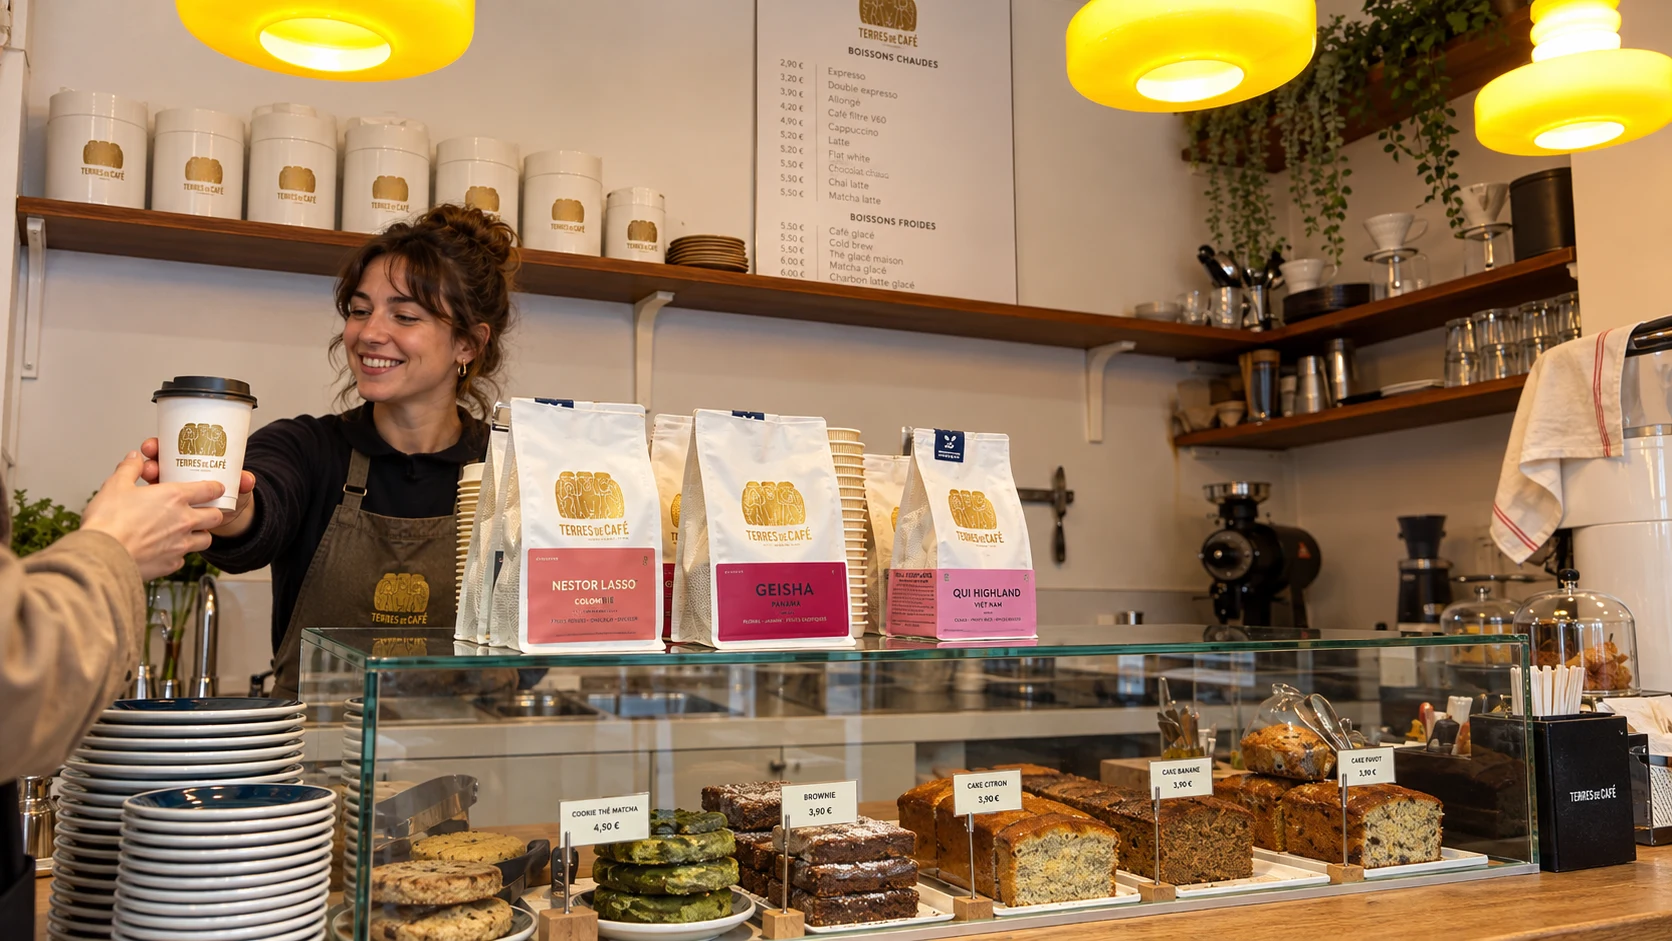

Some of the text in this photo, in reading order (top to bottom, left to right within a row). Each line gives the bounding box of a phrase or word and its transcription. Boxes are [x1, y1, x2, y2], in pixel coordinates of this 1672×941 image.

[859, 27, 888, 42] TERRES
[897, 34, 918, 48] CAFÉ
[848, 46, 938, 69] BOISSONS CHAUDES
[799, 62, 804, 70] €
[799, 76, 804, 84] €
[828, 67, 866, 81] Expresso
[799, 90, 804, 98] €
[828, 80, 898, 99] Double expresso
[828, 95, 861, 108] Allongé
[799, 104, 804, 112] €
[828, 108, 887, 124] Café filtre V60
[799, 119, 804, 127] €
[828, 122, 879, 137] Cappuccino
[799, 133, 804, 141] €
[828, 136, 850, 147] Latte
[799, 147, 804, 155] €
[828, 149, 871, 163] Flat white
[799, 161, 804, 170] €
[799, 176, 804, 184] €
[828, 178, 869, 190] Chai latte
[799, 190, 804, 198] €
[828, 191, 882, 205] Matcha latte
[799, 223, 804, 232] €
[850, 213, 936, 231] BOISSONS FROIDES
[799, 235, 804, 243] €
[829, 227, 875, 240] Café glacé
[799, 246, 804, 255] €
[829, 239, 873, 251] Cold brew
[799, 258, 804, 267] €
[829, 250, 904, 266] Thé glacé maison
[799, 270, 805, 278] €
[829, 261, 887, 275] Matcha glacé
[829, 273, 916, 290] Charbon latte glacé
[175, 458, 201, 468] TERRES
[210, 459, 226, 470] CAFÉ
[559, 520, 629, 536] TERRES DE CAFÉ
[746, 526, 812, 542] TERRES DE CAFÉ
[956, 531, 979, 543] TERRES
[986, 531, 1004, 544] CAFÉ
[552, 579, 637, 591] NESTOR LASSO
[755, 582, 815, 597] GEISHA
[953, 588, 1021, 599] QUI HIGHLAND
[771, 600, 802, 608] PANAMA
[408, 612, 428, 625] CAFÉ
[1177, 766, 1200, 775] BANANE
[984, 780, 1007, 788] CITRON
[1188, 780, 1193, 788] €
[804, 791, 836, 801] BROWNIE
[978, 794, 1000, 804] 3,90 €
[1569, 790, 1594, 802] TERRES
[1601, 784, 1617, 799] CAFÉ
[571, 805, 639, 818] COOKIE THÉ MATCHA
[808, 806, 833, 817] 3,90 €
[593, 821, 620, 833] 4,50 €
